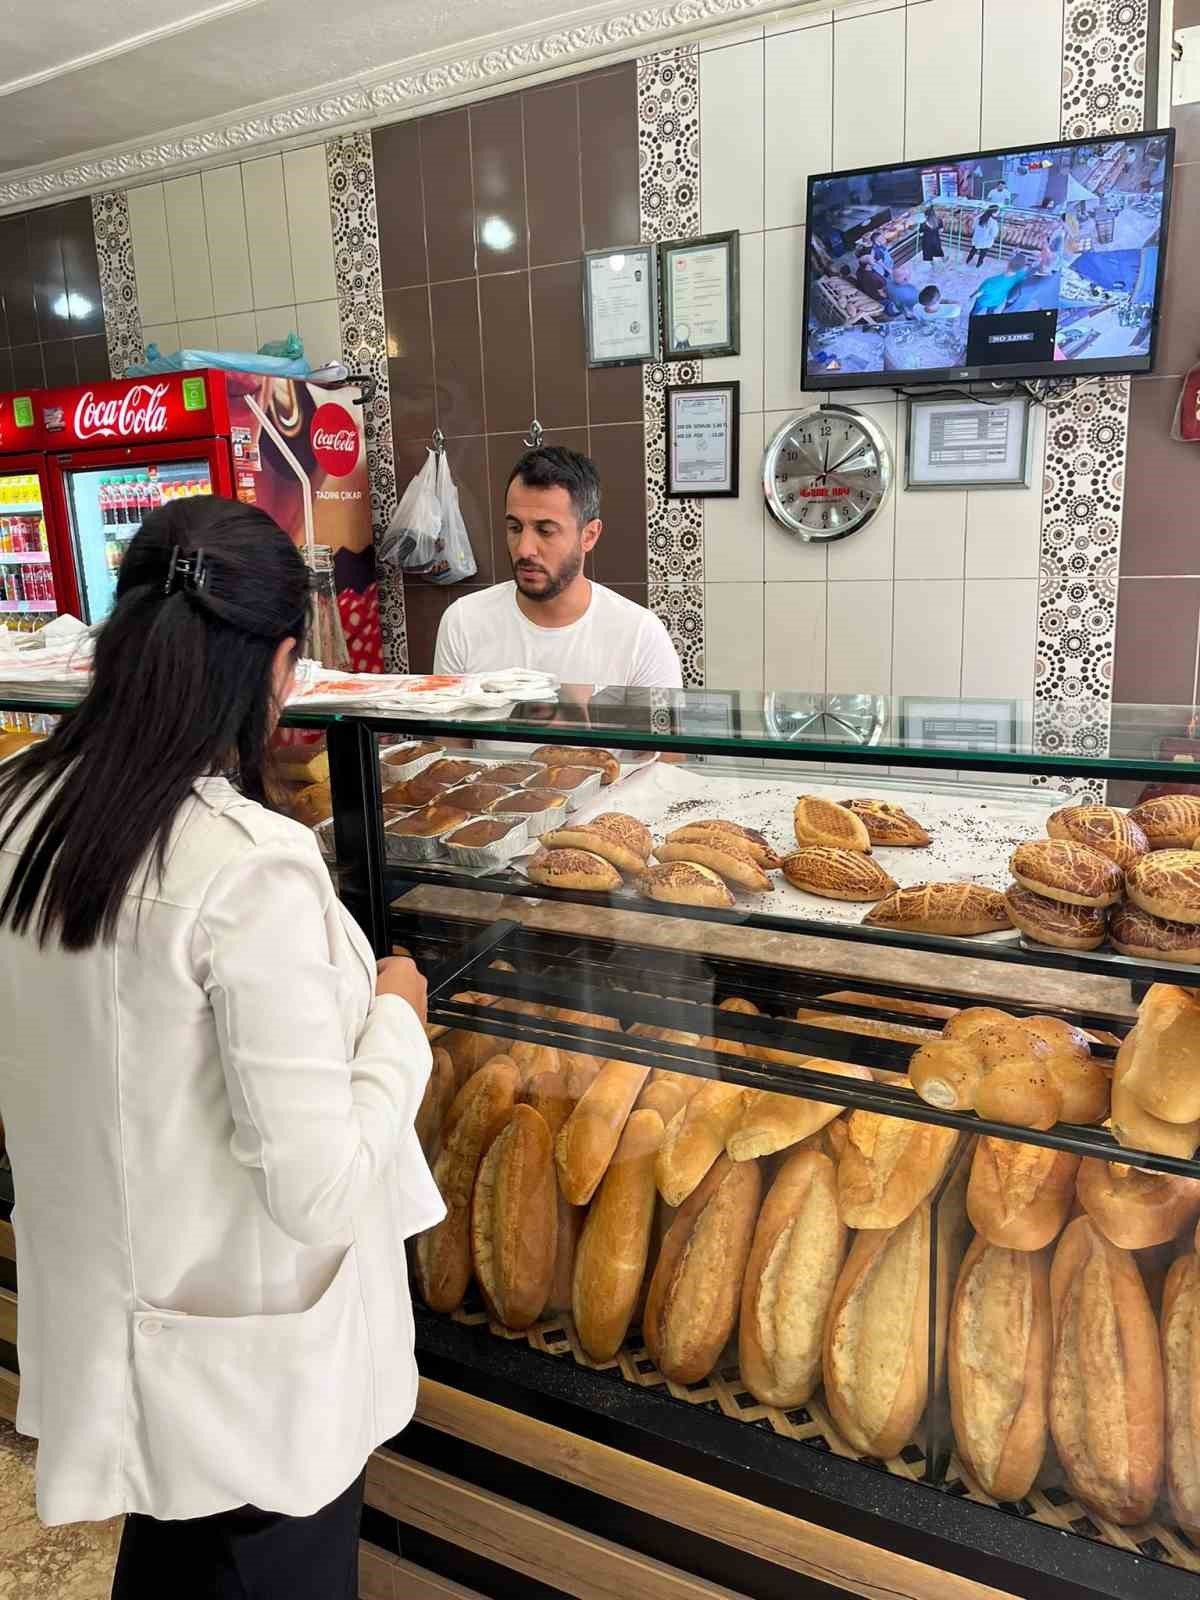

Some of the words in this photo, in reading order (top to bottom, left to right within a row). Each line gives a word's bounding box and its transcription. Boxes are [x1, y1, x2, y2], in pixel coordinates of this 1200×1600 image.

[74, 383, 169, 440] Coca-Cola
[821, 426, 832, 437] 12
[844, 431, 849, 441] 1
[802, 433, 812, 443] 11
[787, 451, 798, 461] 10
[859, 447, 866, 457] 2
[781, 473, 788, 483] 9
[864, 468, 871, 479] 3
[788, 493, 795, 502] 8
[801, 507, 808, 517] 7
[822, 511, 829, 521] 6
[842, 506, 849, 516] 5
